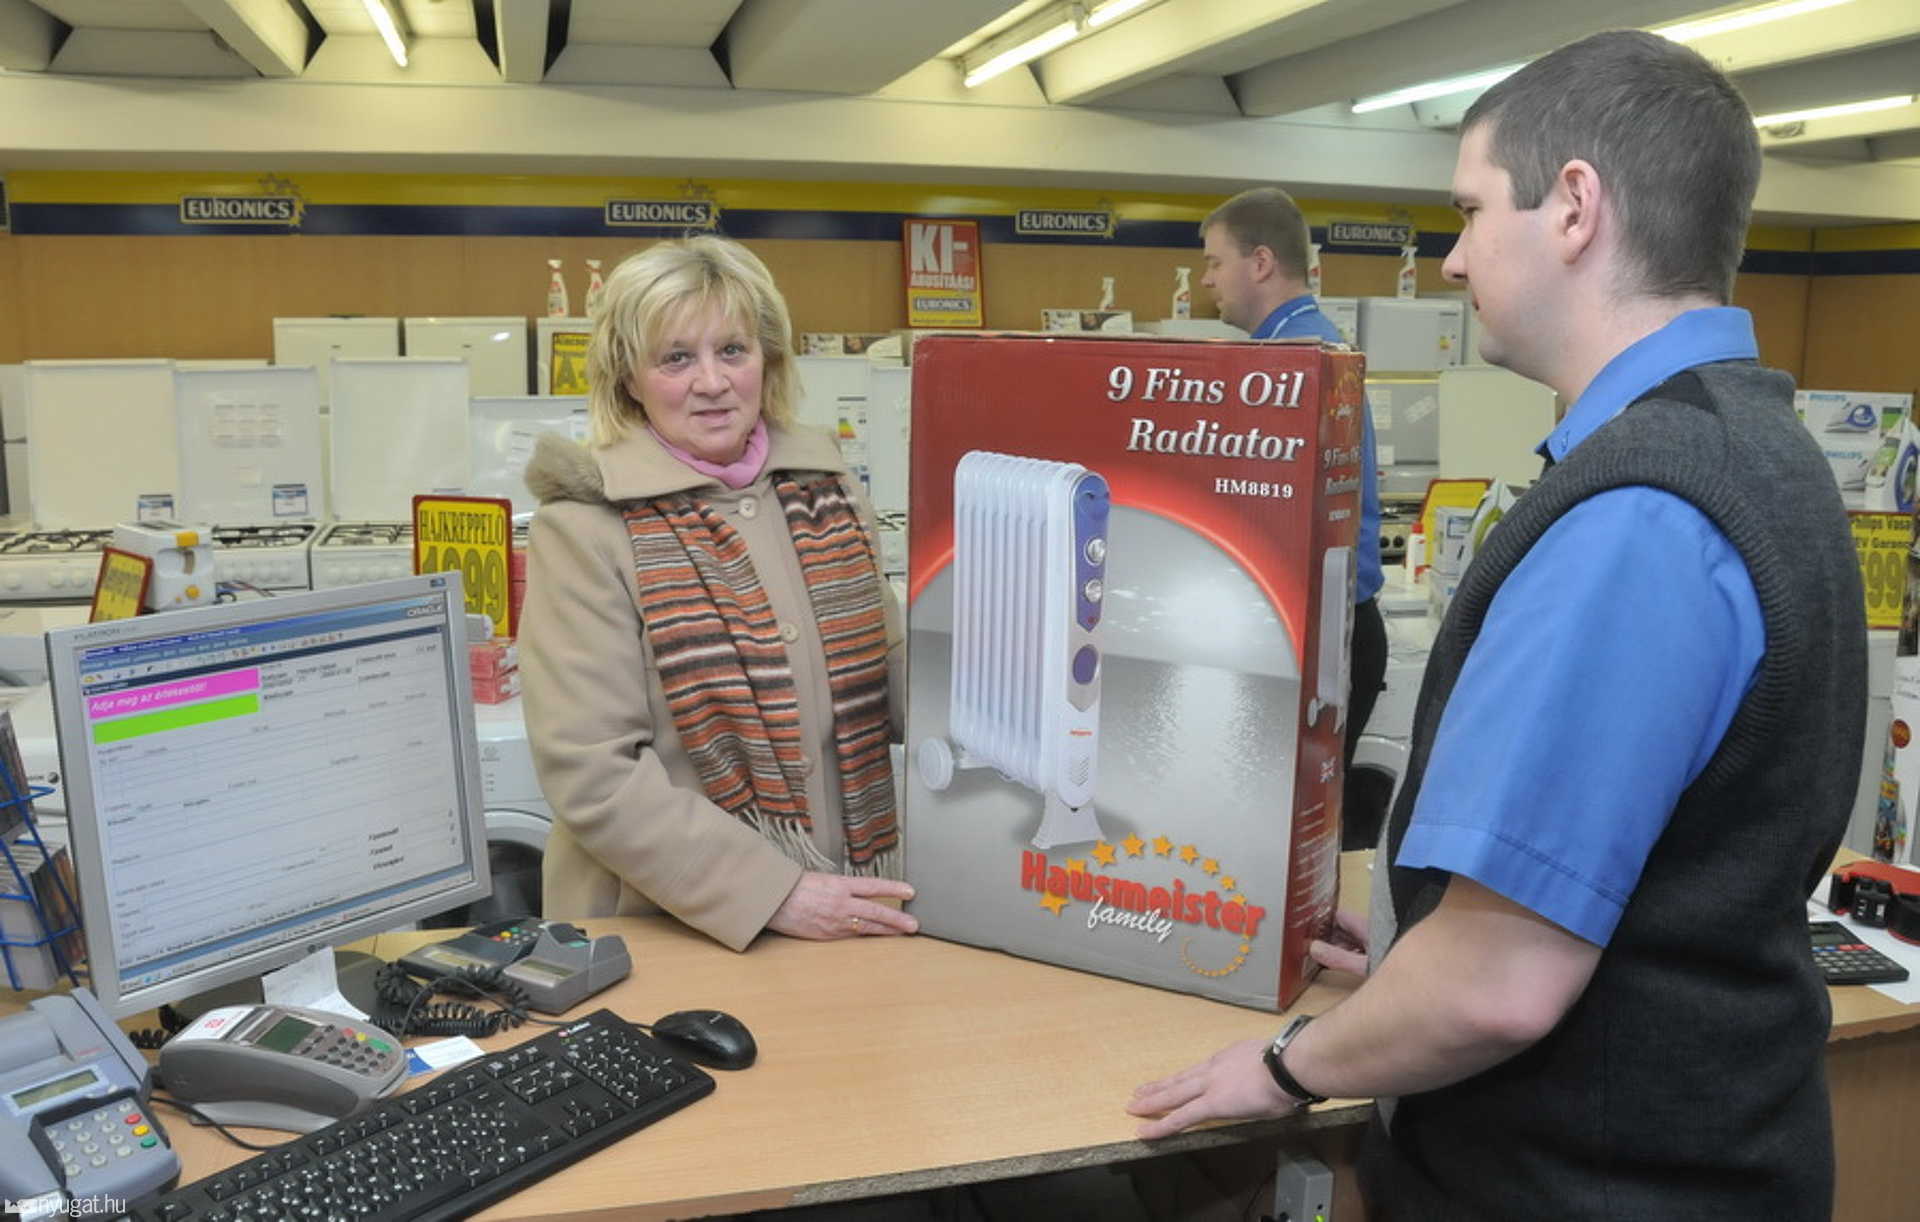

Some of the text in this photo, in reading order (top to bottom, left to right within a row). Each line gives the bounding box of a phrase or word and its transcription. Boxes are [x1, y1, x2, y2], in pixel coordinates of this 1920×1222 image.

[186, 199, 290, 219] EURONICS
[611, 203, 706, 222] EURONICS
[1023, 212, 1106, 230] EURONICS
[1334, 224, 1407, 242] EURONICS
[910, 223, 968, 273] KI-
[916, 298, 971, 310] EURONICS
[1107, 366, 1305, 409] 9 Fins Oil
[1126, 418, 1305, 462] Radiator
[1214, 477, 1296, 499] HM8819
[1021, 849, 1266, 937] Hausmeister
[1087, 894, 1173, 942] family
